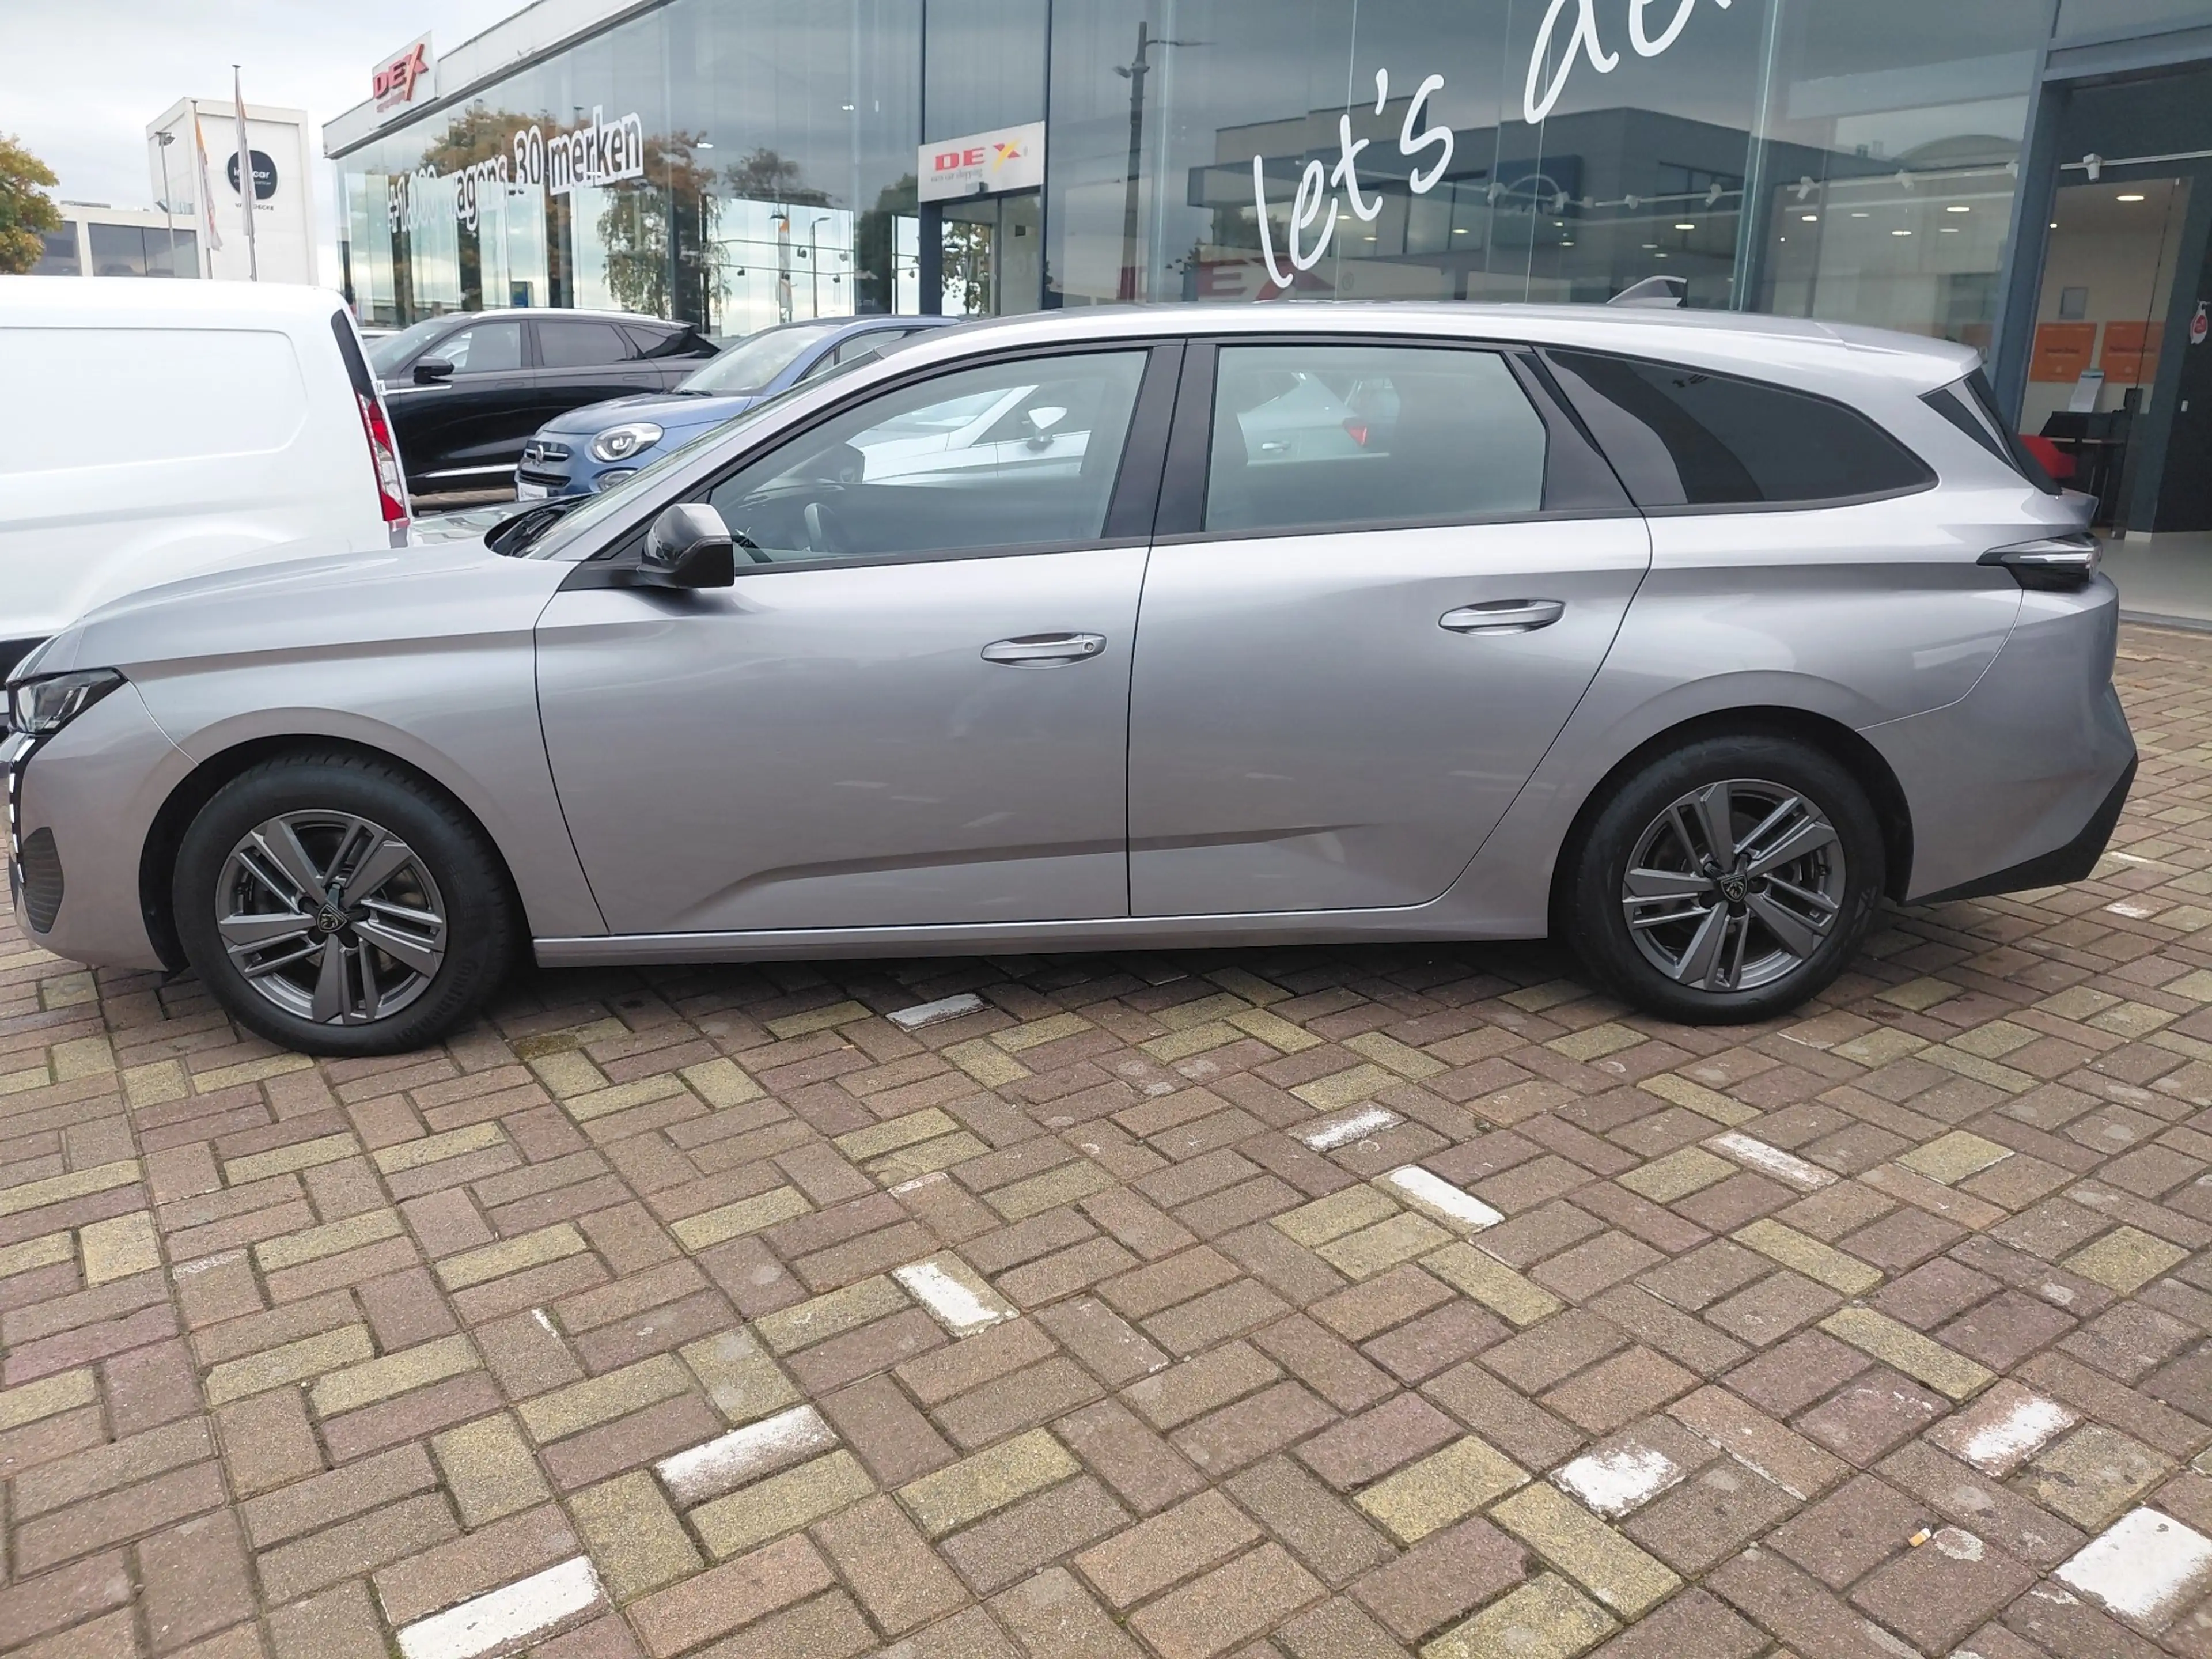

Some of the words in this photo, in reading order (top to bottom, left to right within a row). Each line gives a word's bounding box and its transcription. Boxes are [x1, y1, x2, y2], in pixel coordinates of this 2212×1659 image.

[373, 43, 429, 101] DEX
[548, 105, 644, 196] merken
[935, 137, 1022, 173] DEX
[1253, 68, 1454, 288] let's
